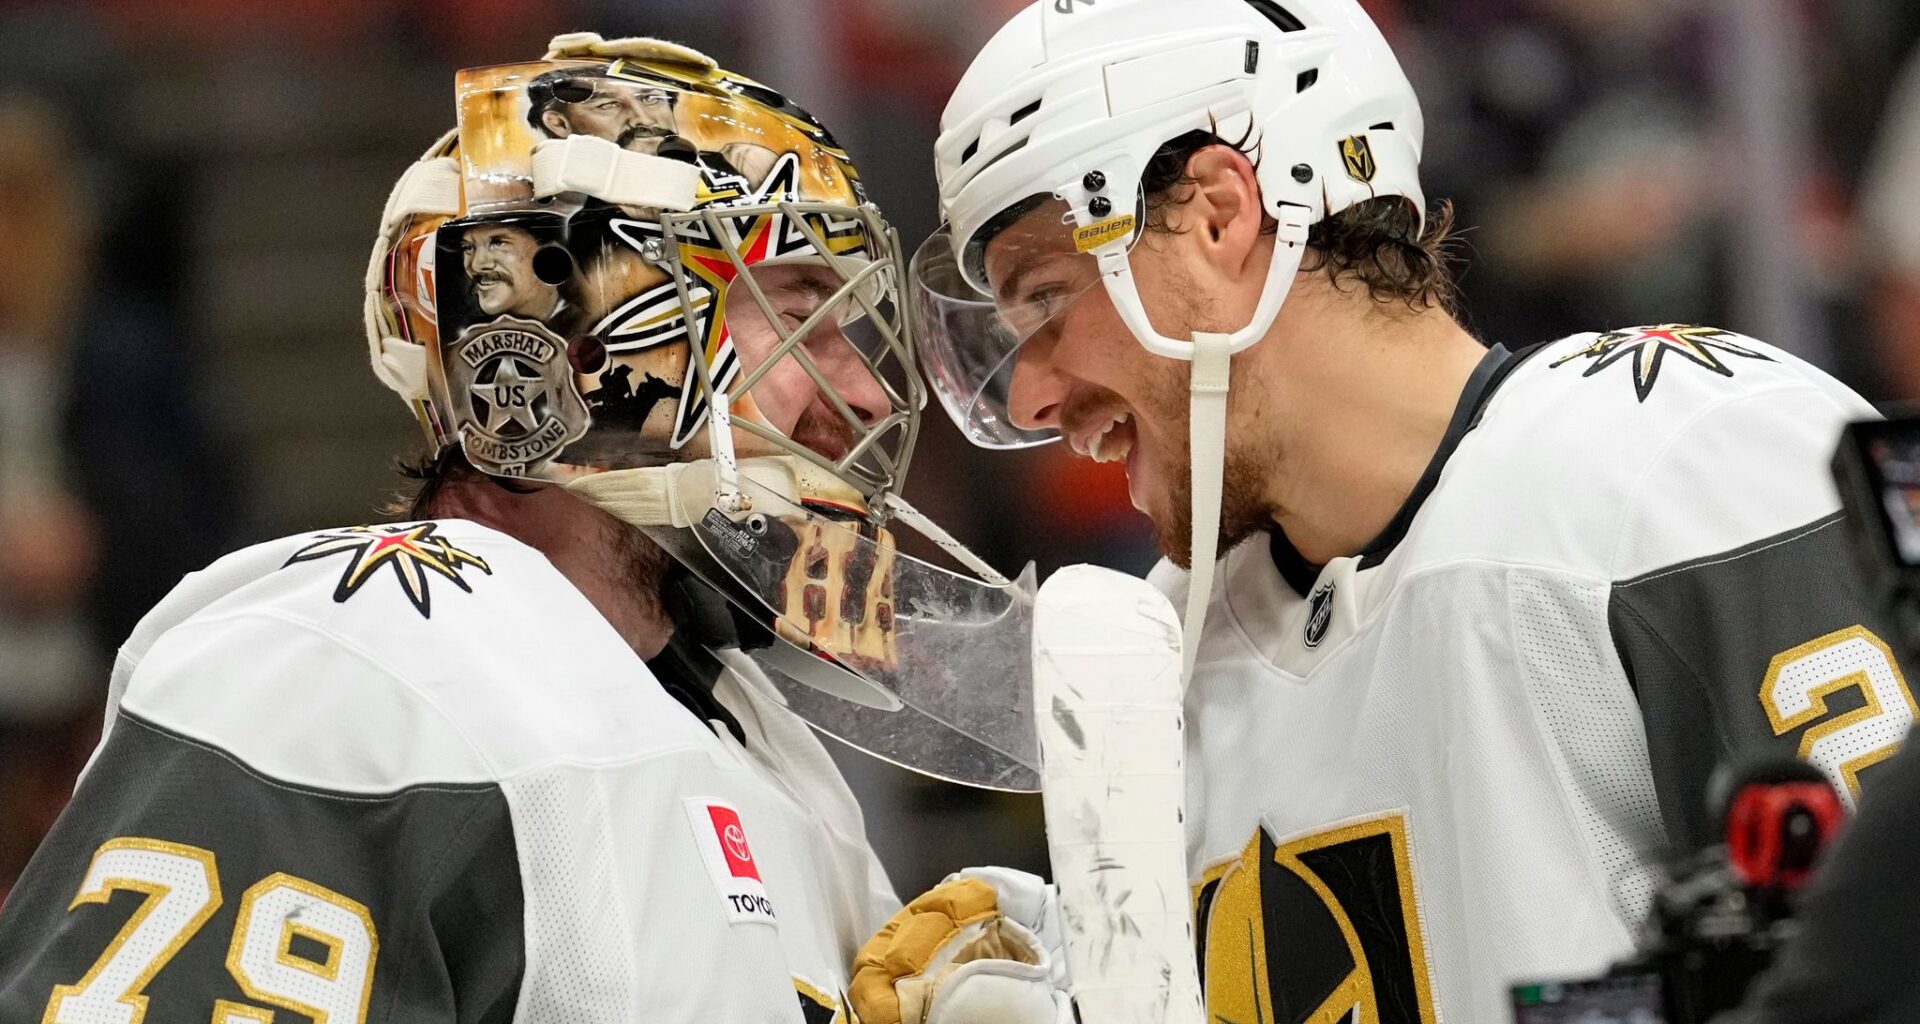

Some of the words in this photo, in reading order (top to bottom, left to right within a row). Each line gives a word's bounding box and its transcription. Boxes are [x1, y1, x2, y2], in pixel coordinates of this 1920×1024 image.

[1078, 218, 1132, 240] BAUER
[465, 332, 543, 364] MARSHAL
[494, 384, 526, 408] US
[463, 420, 566, 460] TOMBSTONE
[1309, 596, 1332, 639] NHL
[727, 894, 776, 919] TOYO
[41, 837, 380, 1024] 79
